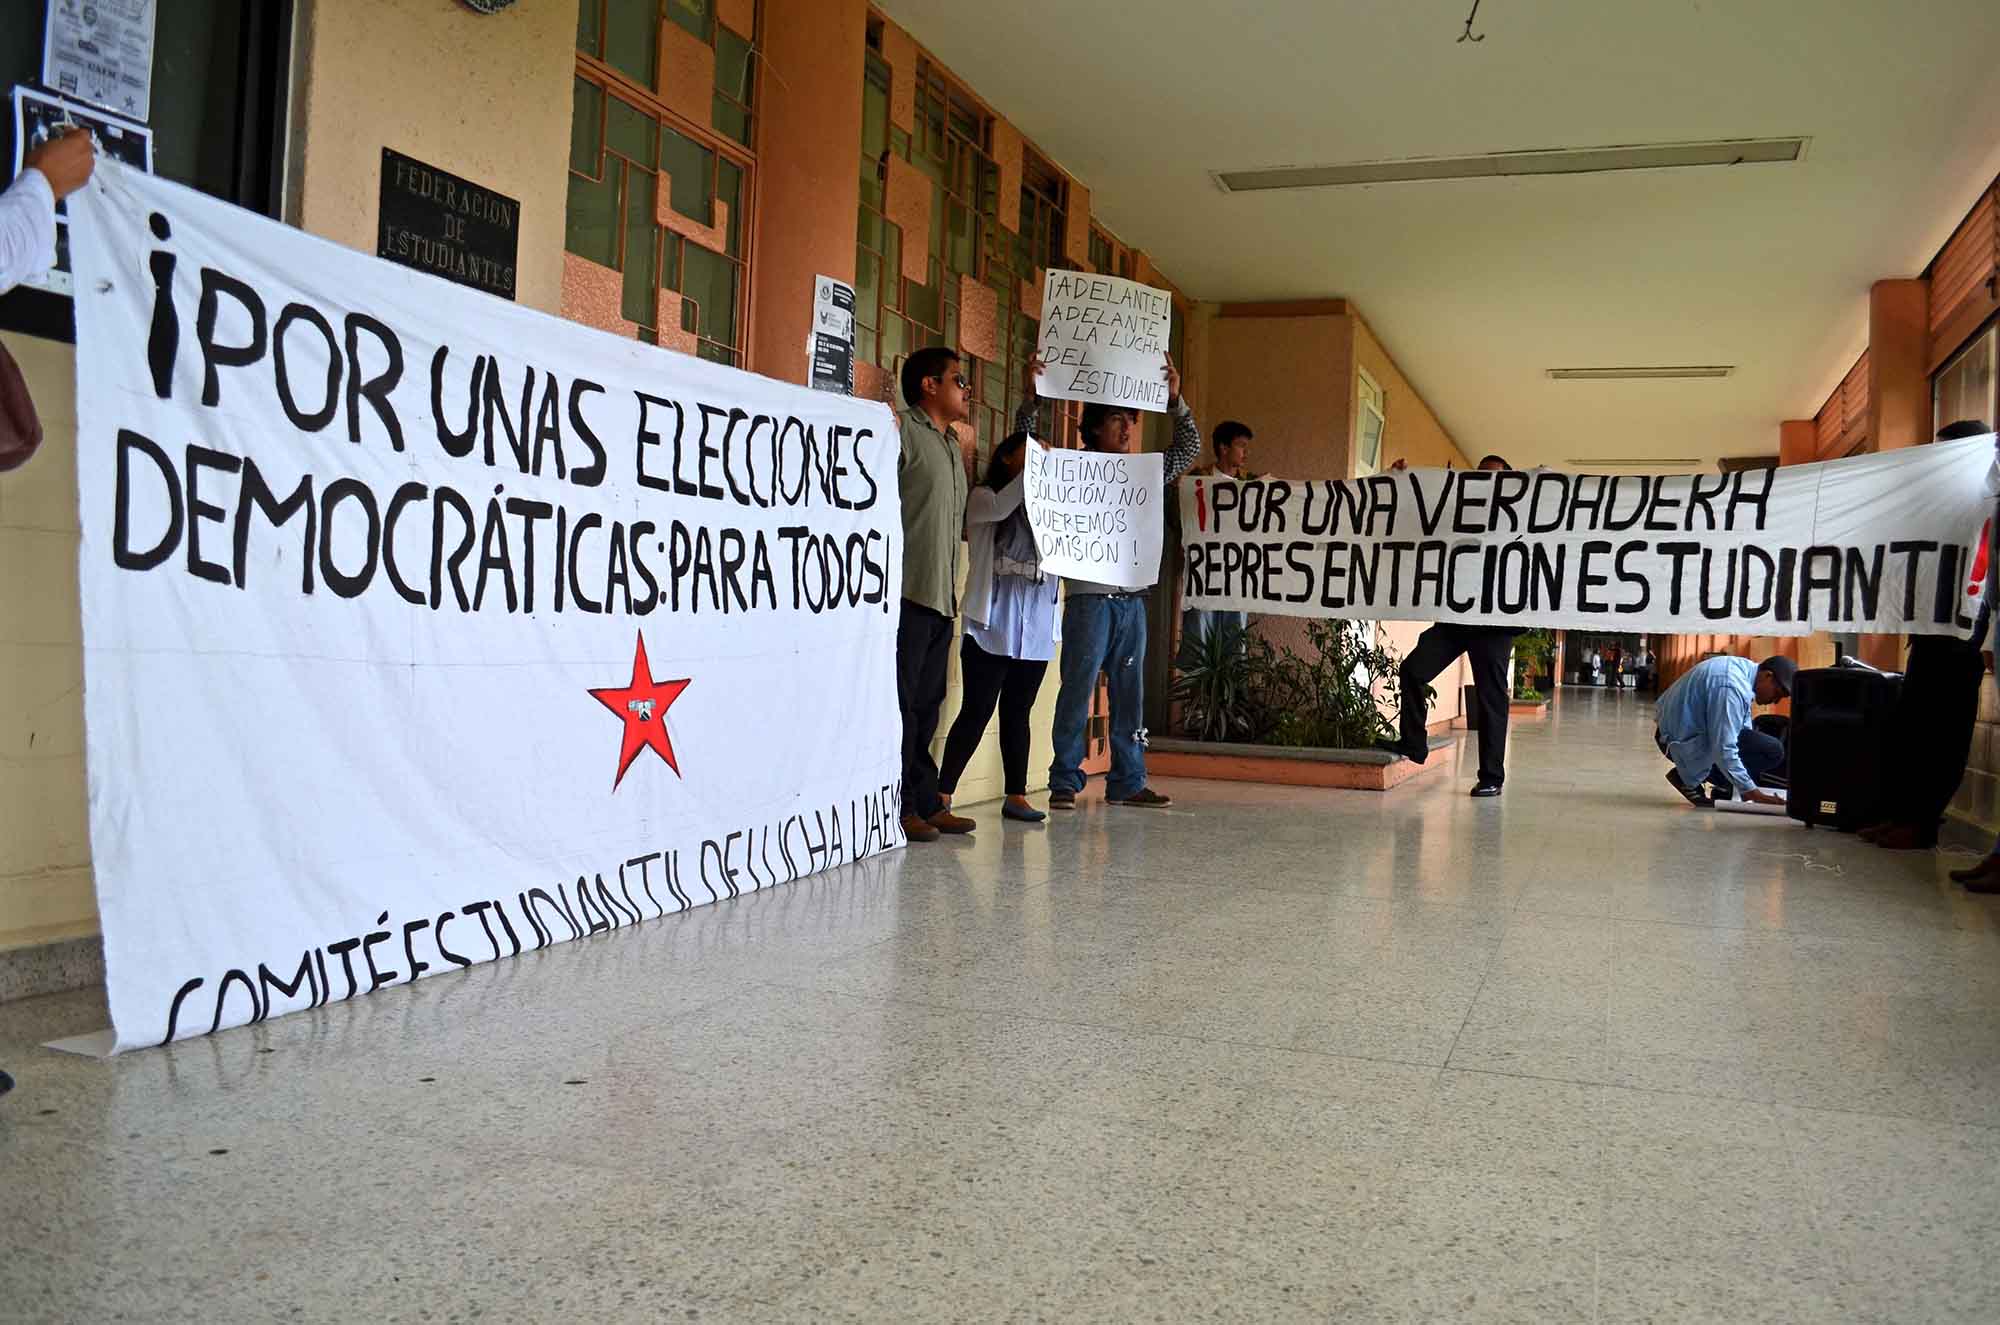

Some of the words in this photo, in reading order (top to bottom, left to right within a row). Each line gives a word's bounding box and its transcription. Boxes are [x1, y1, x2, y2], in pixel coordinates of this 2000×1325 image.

[443, 214, 464, 243] DE
[386, 225, 512, 289] ESTUDIANTES
[1048, 272, 1169, 320] ¡ADELANTE!
[1045, 324, 1059, 339] A
[1072, 325, 1097, 344] LA
[1109, 329, 1160, 355] LUCHA
[1049, 305, 1159, 337] ADELANTE
[147, 212, 405, 453] ¡POR
[430, 345, 606, 487] UNAS
[634, 390, 877, 510] ELECCIONES
[1043, 346, 1096, 366] DEL
[1068, 370, 1166, 404] ESTUDIANTE
[1119, 487, 1147, 506] NO
[1302, 476, 1398, 536] UNA
[1410, 468, 1775, 536] VERDADERA
[778, 526, 890, 614] TODOS!
[1186, 535, 1565, 614] REPRESENTACIÓN
